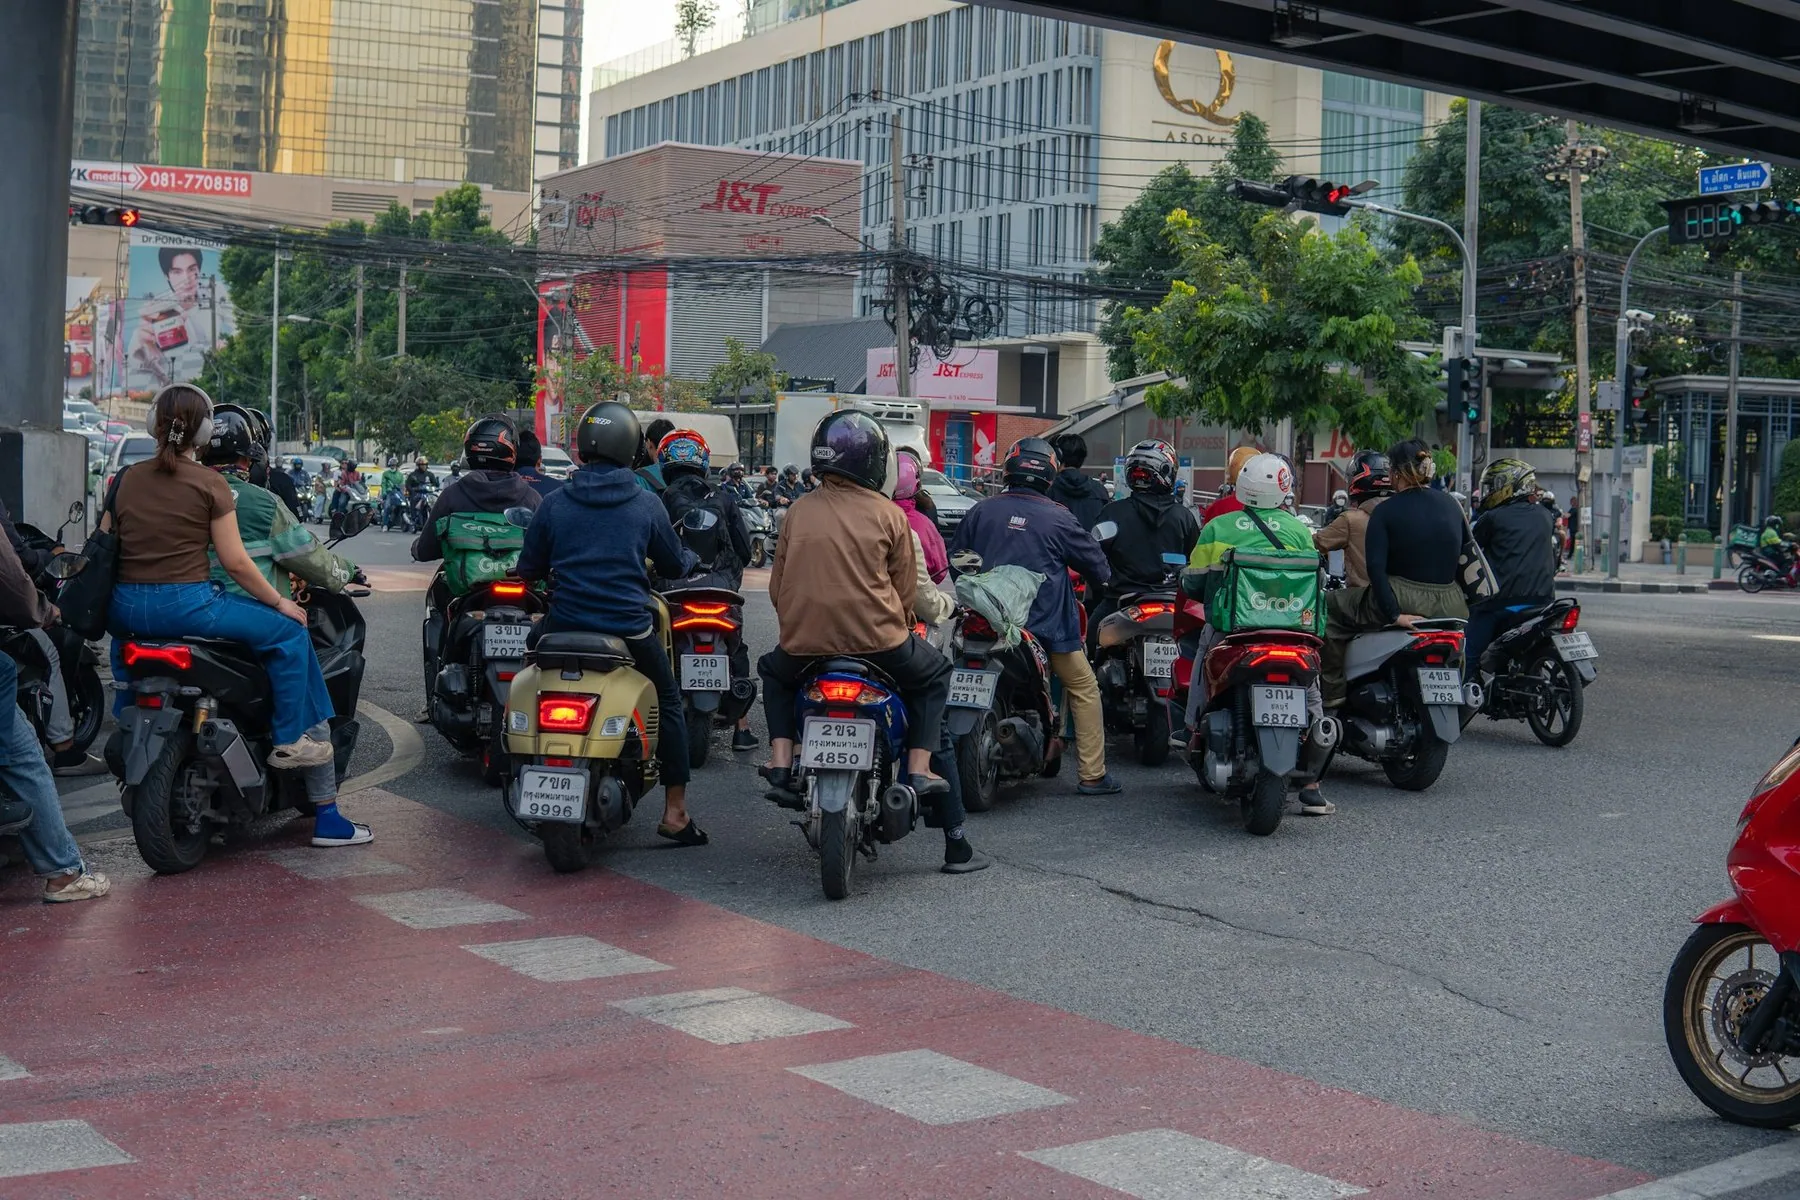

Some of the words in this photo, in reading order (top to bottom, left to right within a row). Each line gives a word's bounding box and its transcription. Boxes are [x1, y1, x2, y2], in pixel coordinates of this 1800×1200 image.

[92, 171, 127, 182] media
[150, 171, 248, 192] 081-7708518
[700, 180, 784, 215] J&T
[932, 363, 962, 377] J&T
[1182, 436, 1225, 450] EXPRESS
[1320, 427, 1355, 458] J&
[814, 448, 833, 457] SHOEI
[1250, 592, 1304, 612] Grab
[491, 647, 526, 657] 7075
[689, 678, 722, 688] 2566
[951, 692, 977, 704] 531
[1432, 692, 1454, 703] 763
[1261, 712, 1299, 725] 6876
[808, 739, 868, 750] กรุงเทพมหานคร
[813, 751, 860, 765] 4850
[523, 790, 580, 803] กรุงเทพมหานคร
[529, 802, 573, 818] 9996
